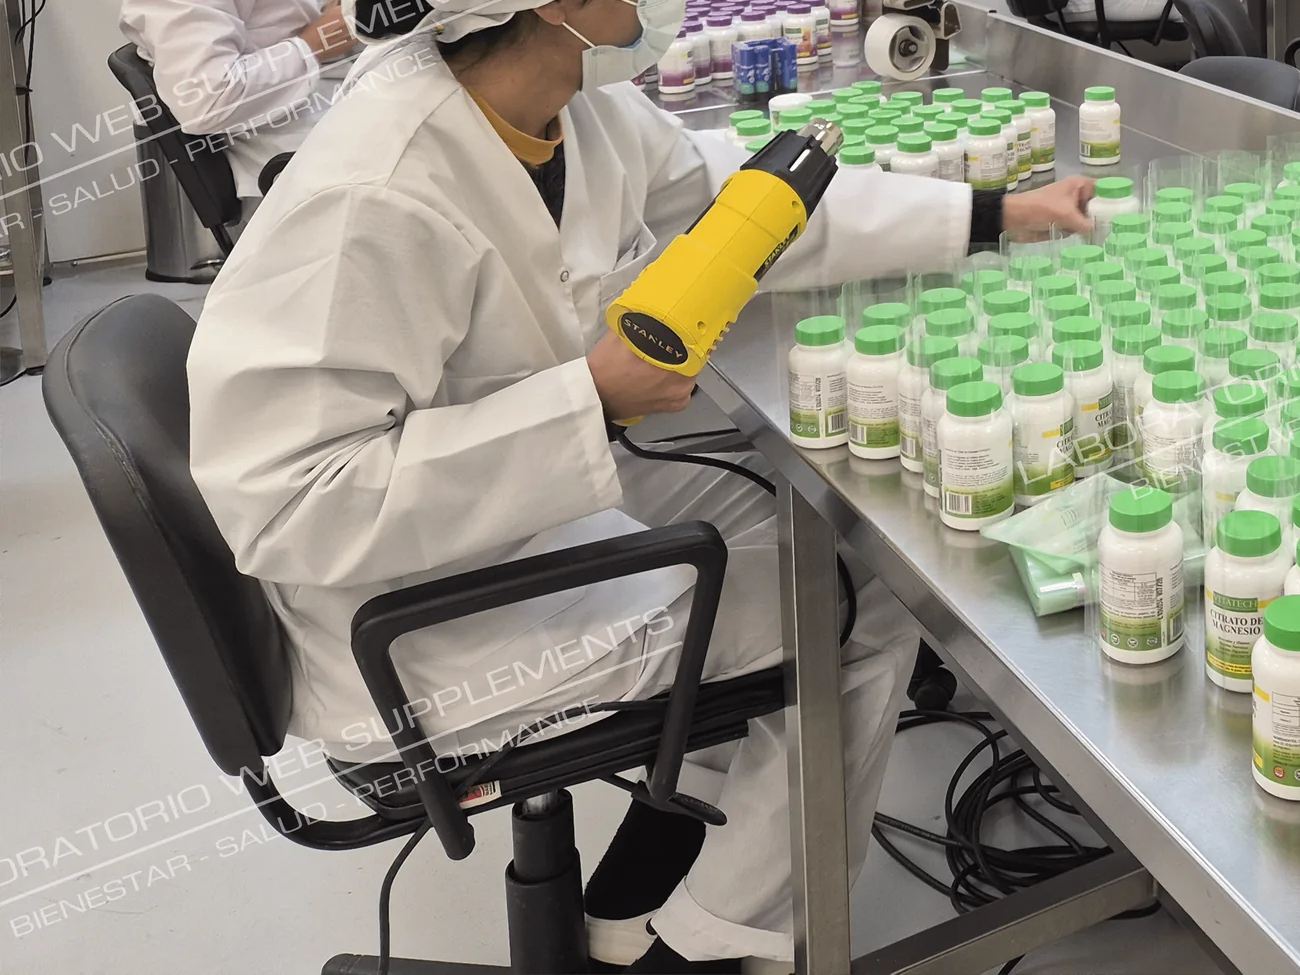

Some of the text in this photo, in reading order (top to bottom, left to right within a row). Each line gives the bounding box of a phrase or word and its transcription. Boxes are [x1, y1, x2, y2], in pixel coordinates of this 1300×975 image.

[624, 319, 683, 358] STANLEY
[1210, 609, 1263, 626] CITRATO DE
[1212, 620, 1261, 636] MAGNESIO
